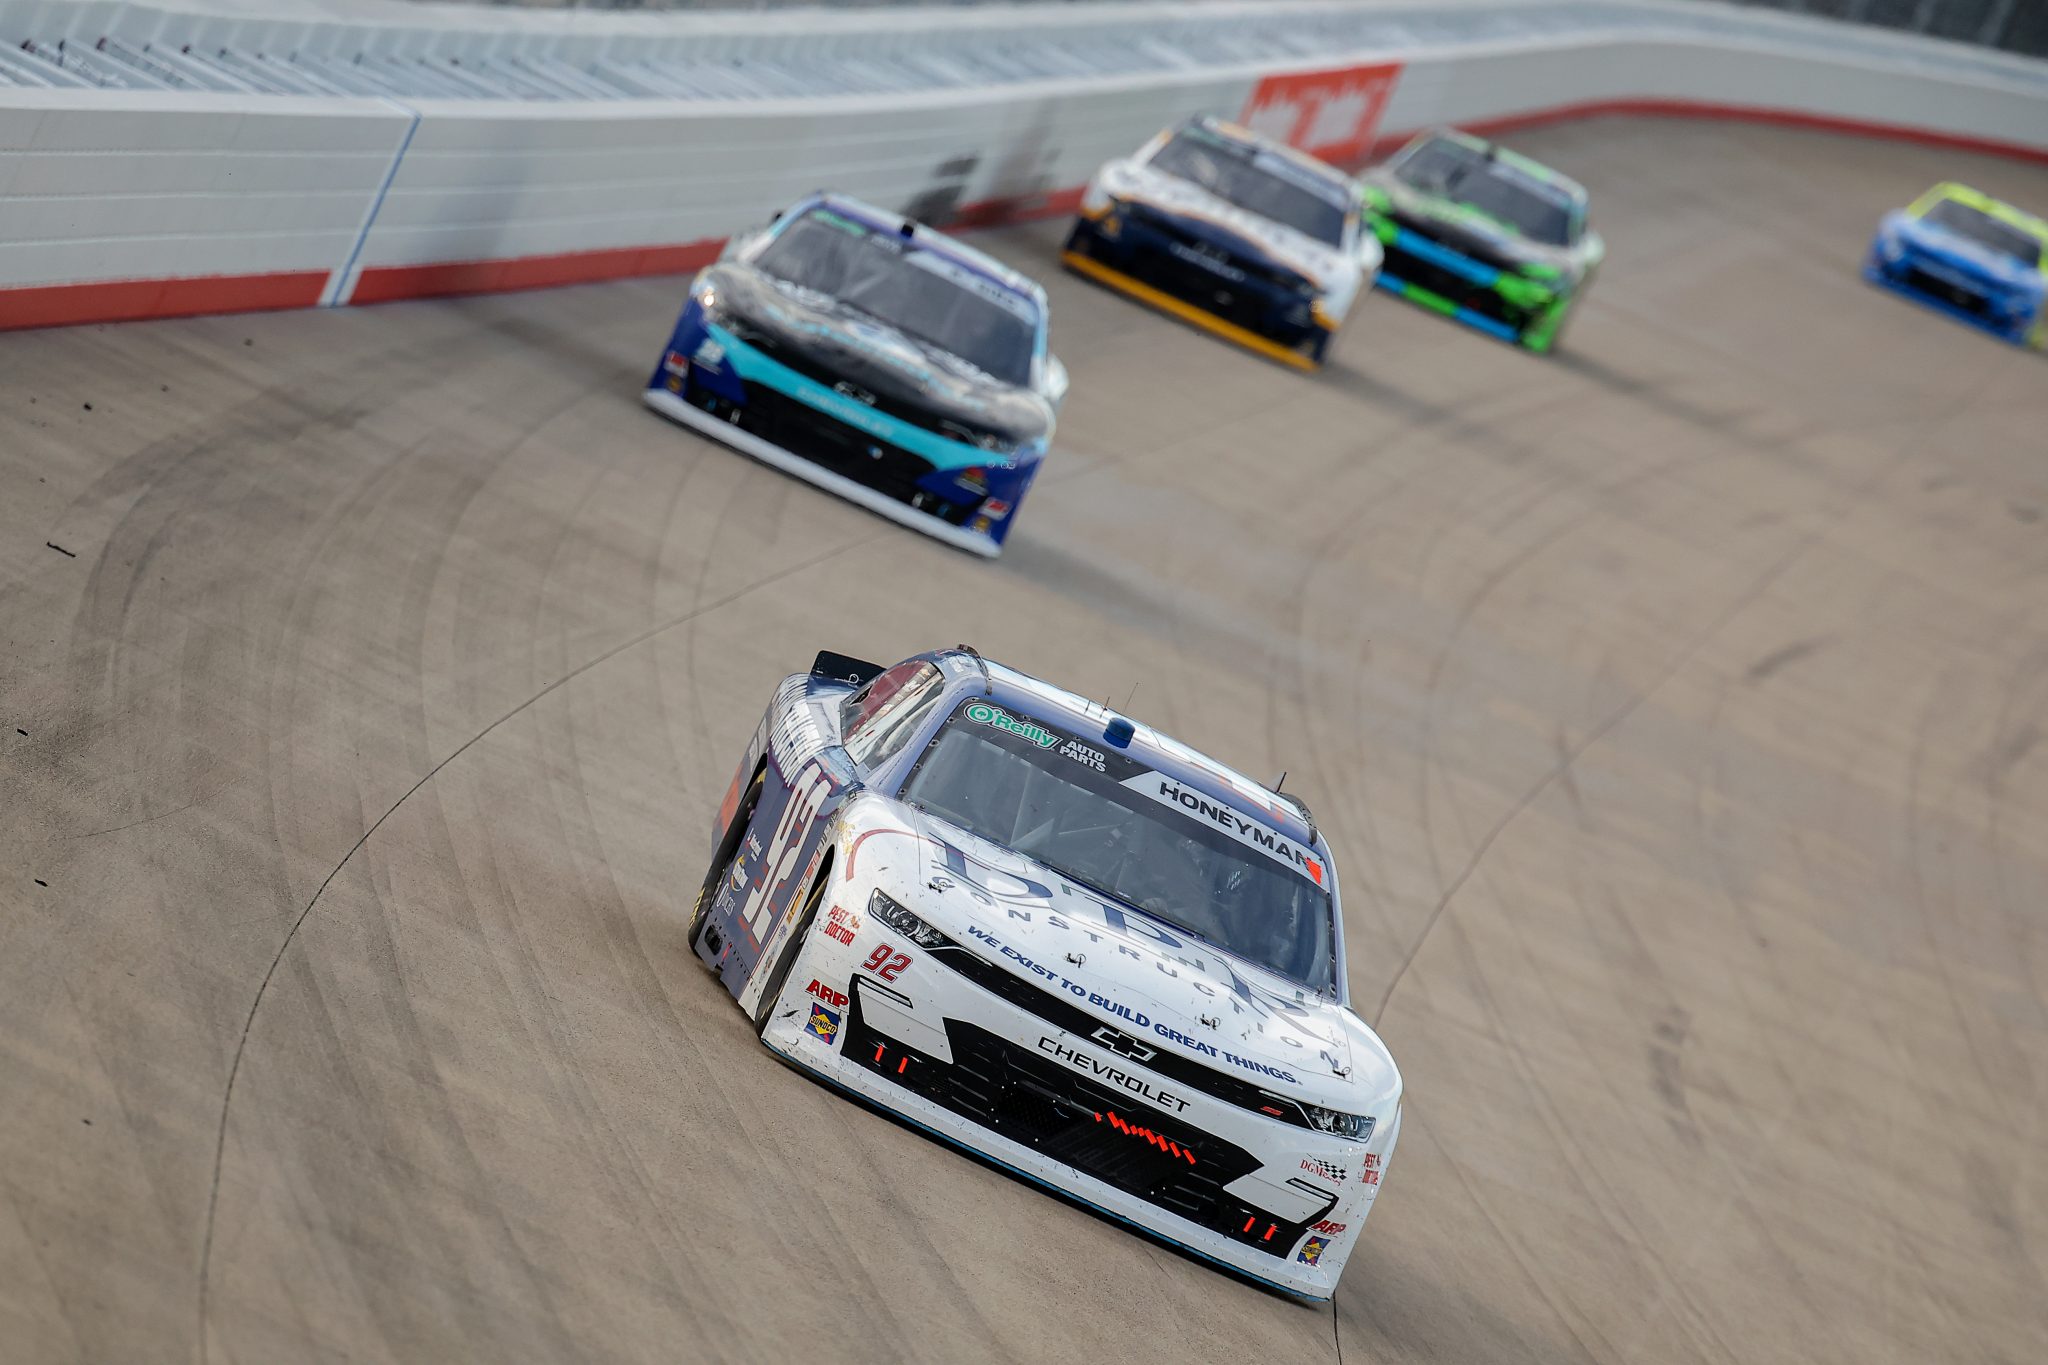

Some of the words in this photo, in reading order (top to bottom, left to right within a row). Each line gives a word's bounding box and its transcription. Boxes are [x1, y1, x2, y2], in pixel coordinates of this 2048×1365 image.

[967, 704, 1058, 748] O'Reilly
[1059, 746, 1107, 772] PARTS
[1067, 740, 1105, 762] AUTO
[742, 762, 832, 945] 92
[828, 904, 850, 924] PEST
[823, 920, 856, 947] DOCTOR
[861, 943, 914, 984] 92
[931, 876, 1340, 1069] CONSTRUCTION
[806, 978, 849, 1008] ARP
[967, 925, 1001, 948] WE
[1000, 945, 1058, 980] EXIST
[1061, 977, 1086, 997] TO
[1088, 992, 1151, 1028] BUILD
[1154, 1023, 1219, 1057] GREAT
[809, 1014, 838, 1034] SUNOCO
[1037, 1036, 1191, 1112] CHEVROLET
